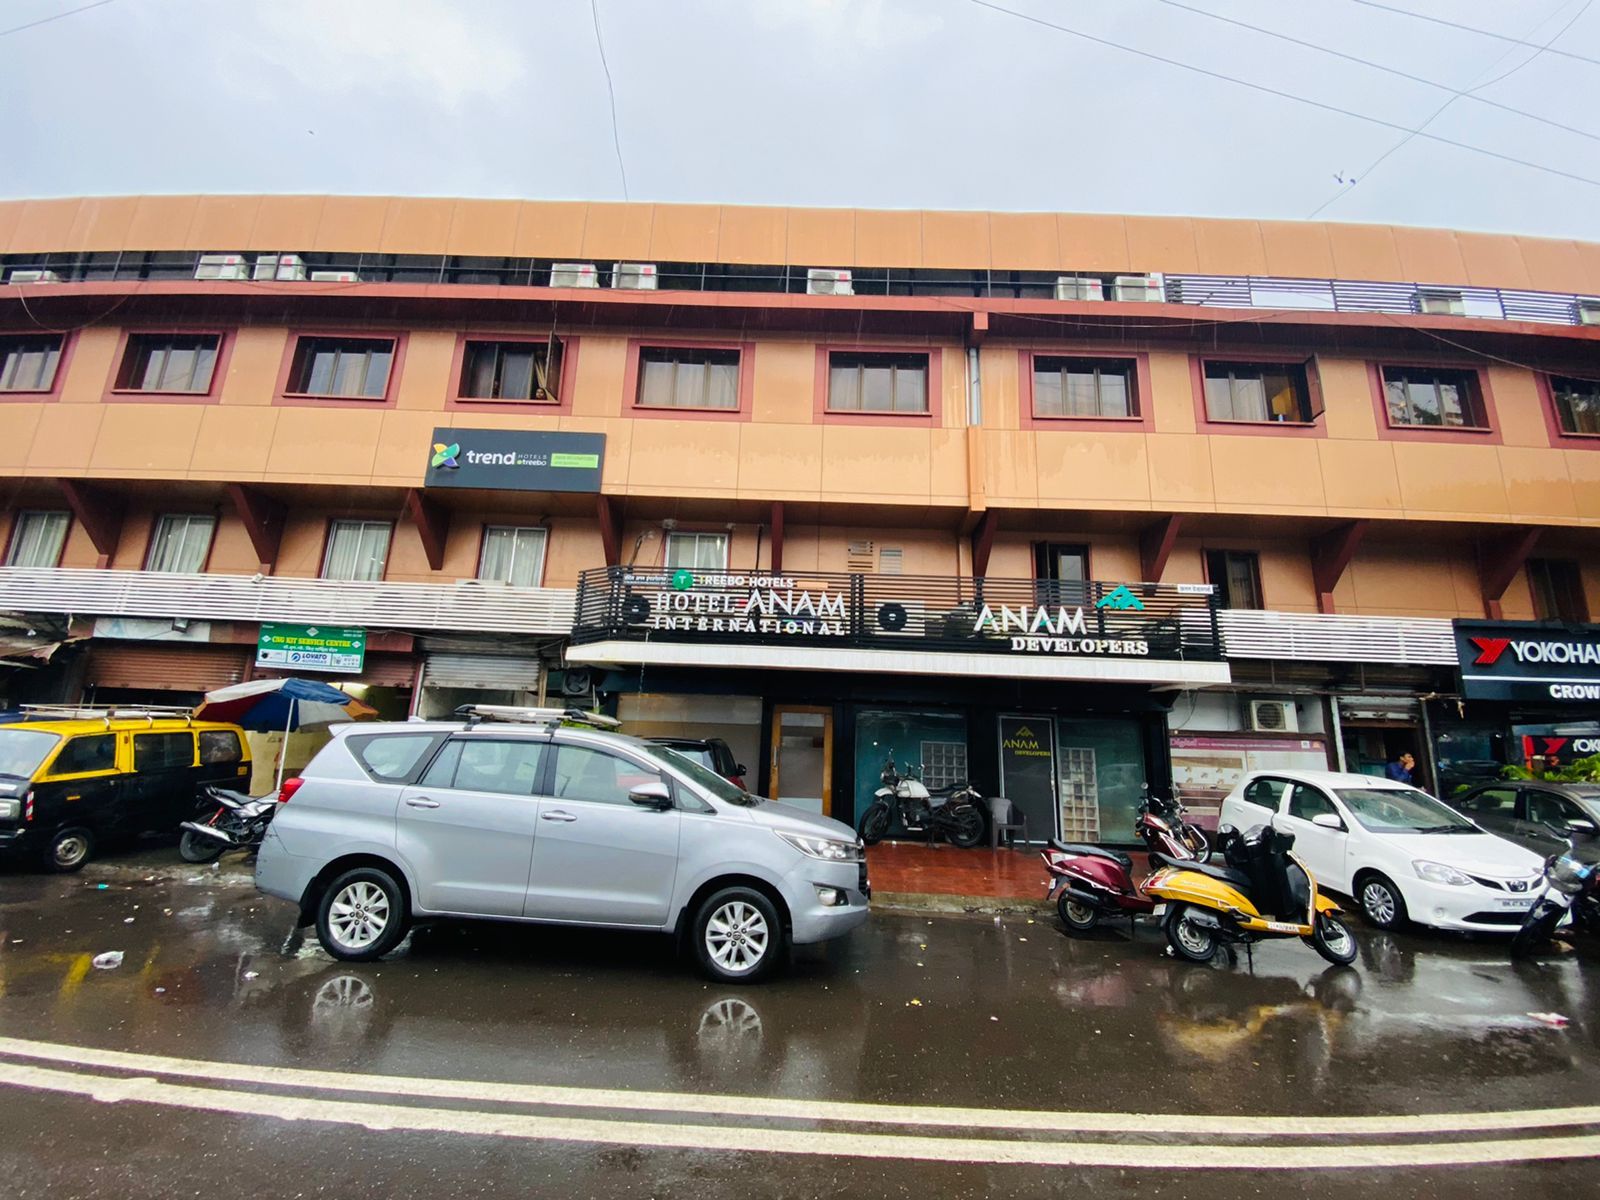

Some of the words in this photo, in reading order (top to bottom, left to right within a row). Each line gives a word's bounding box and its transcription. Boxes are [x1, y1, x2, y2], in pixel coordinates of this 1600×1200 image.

[466, 450, 516, 465] trend
[700, 576, 745, 587] TREEBO
[749, 577, 794, 588] HOTELS
[656, 592, 735, 613] HOTEL
[744, 589, 846, 617] ANAM
[653, 616, 846, 636] INTERNATIONAL
[973, 604, 1087, 635] ANAM
[298, 637, 325, 645] SERVICE
[1011, 637, 1149, 655] DEVELOPERS
[1510, 641, 1600, 664] YOKOHA
[1003, 740, 1039, 749] ANAM
